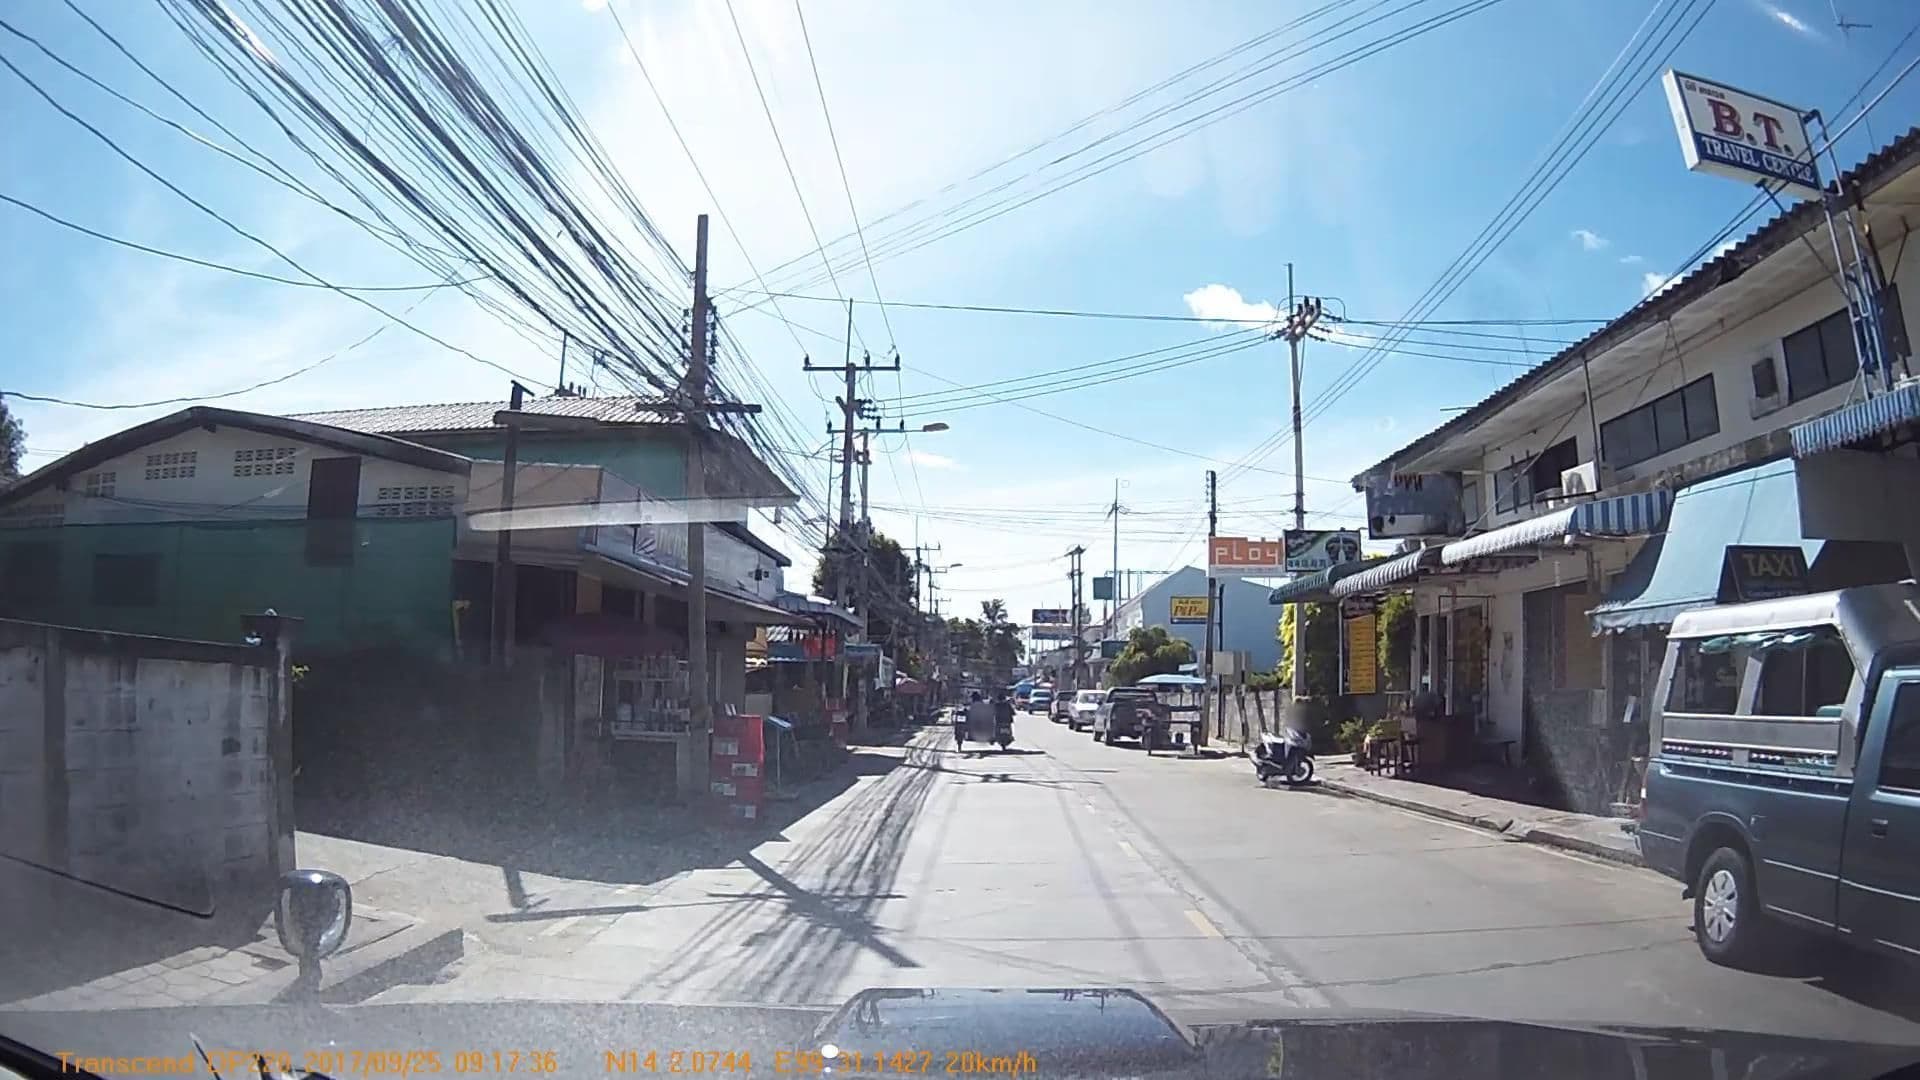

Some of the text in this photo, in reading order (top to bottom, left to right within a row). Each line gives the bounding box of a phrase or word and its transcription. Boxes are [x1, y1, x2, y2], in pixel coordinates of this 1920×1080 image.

[1708, 98, 1794, 156] B.T.
[1701, 137, 1760, 167] TRAVEL
[1743, 553, 1798, 577] TAXI
